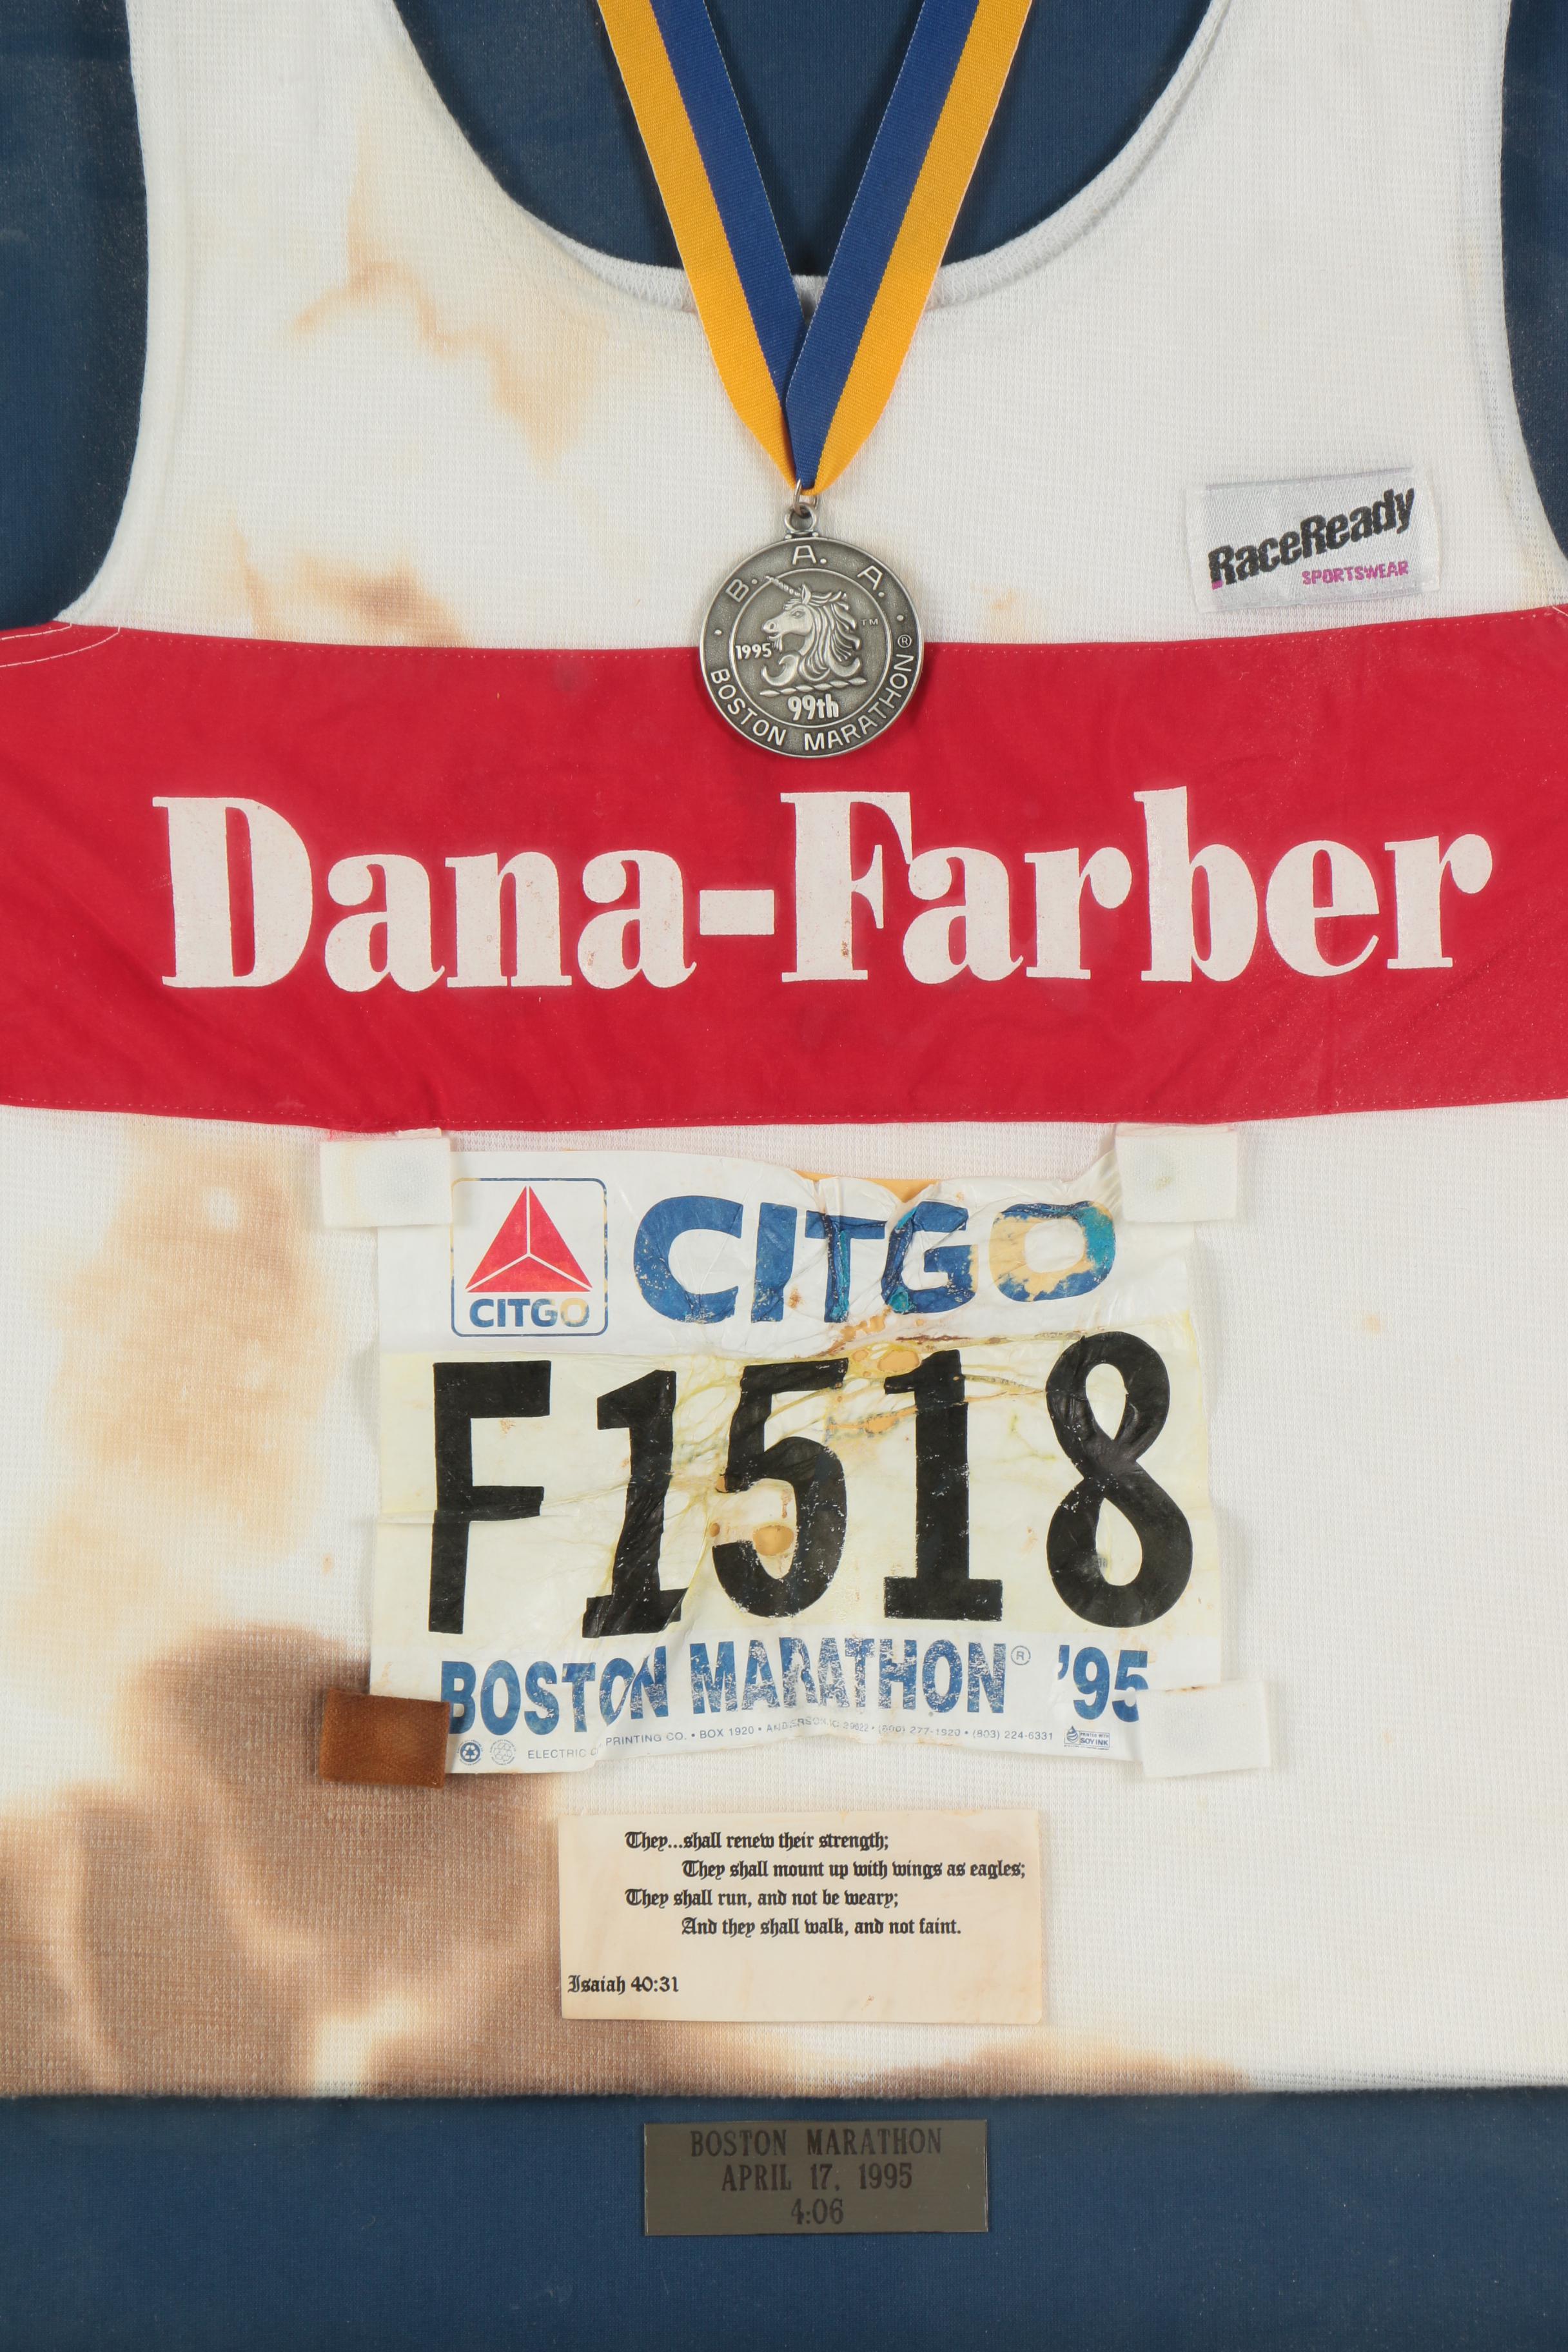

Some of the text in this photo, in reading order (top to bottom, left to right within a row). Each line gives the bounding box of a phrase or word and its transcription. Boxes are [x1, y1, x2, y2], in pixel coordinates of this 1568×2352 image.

[1208, 487, 1415, 590] RaceReady
[1302, 560, 1409, 585] SPORTSWEAR
[735, 643, 772, 660] 1995
[710, 668, 787, 746] BOSTON
[788, 693, 839, 721] 99th
[152, 785, 1493, 992] Dana-Farber
[633, 1195, 1116, 1324] CITGO
[469, 1298, 590, 1328] CITGO
[429, 1331, 1193, 1638] F1518
[440, 1646, 669, 1736] BOSTON
[528, 1748, 587, 1759] ELECTRIC
[605, 1734, 662, 1746] PRINTING
[666, 1732, 687, 1741] CO.
[700, 1729, 723, 1739] BOX
[729, 1726, 754, 1736] 1920
[910, 1726, 961, 1736] 277-1920
[972, 1729, 1000, 1740] (803)
[1004, 1730, 1053, 1740] 224-6331
[726, 1833, 774, 1848] renew
[778, 1831, 814, 1852] their
[818, 1831, 888, 1852] strength;
[681, 1859, 1026, 1880] They shall mount up with wings as eagles;
[625, 1888, 899, 1909] They shall run, and not be weary;
[681, 1917, 961, 1938] And they shall walk, and not faint.
[567, 1975, 679, 1995] Isaiah 40:31
[691, 2128, 942, 2157] BOSTON MARATHON
[721, 2162, 913, 2192] APRIL 17, 1995
[790, 2199, 844, 2225] 4:06
